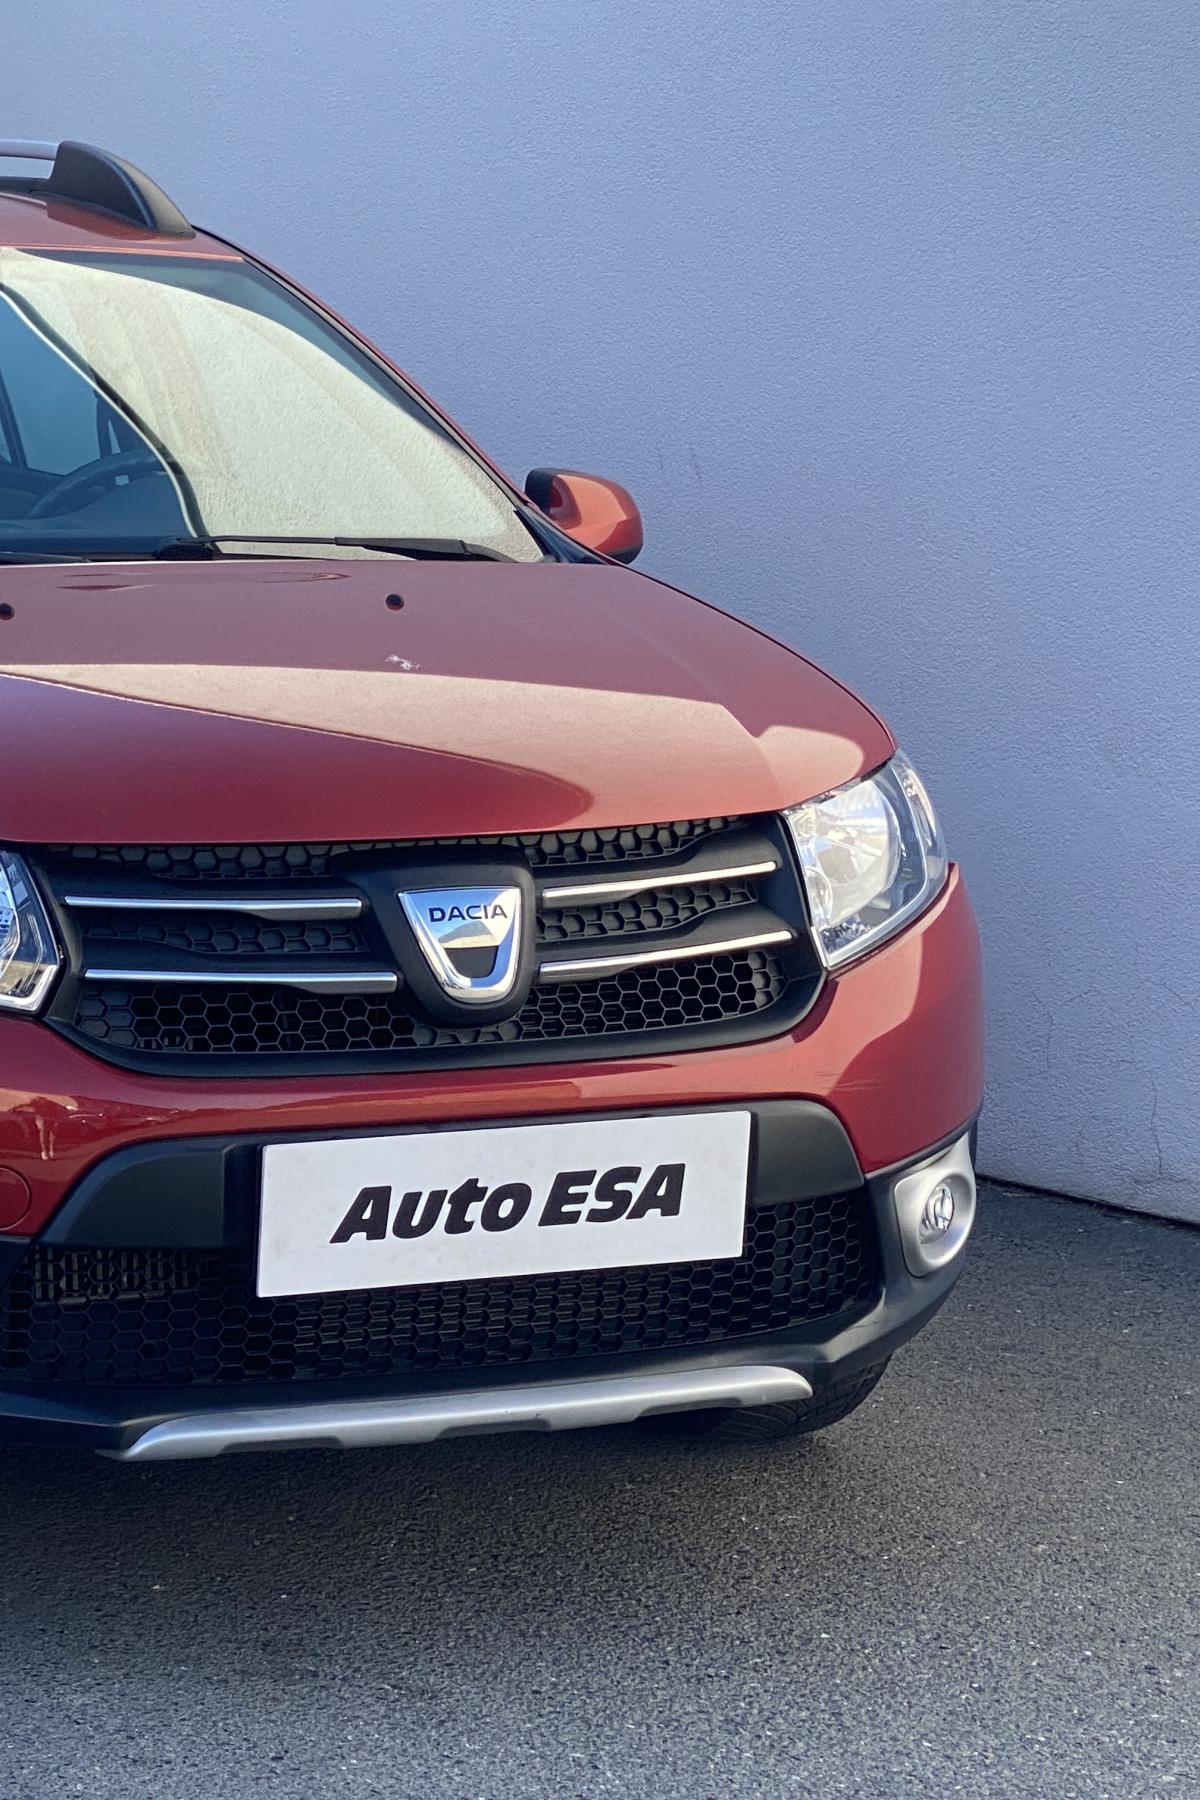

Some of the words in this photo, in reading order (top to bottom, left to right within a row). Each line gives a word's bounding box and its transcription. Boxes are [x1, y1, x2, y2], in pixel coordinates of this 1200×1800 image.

[428, 904, 508, 922] DACIA
[329, 1178, 533, 1244] Auto
[538, 1163, 686, 1227] ESA
